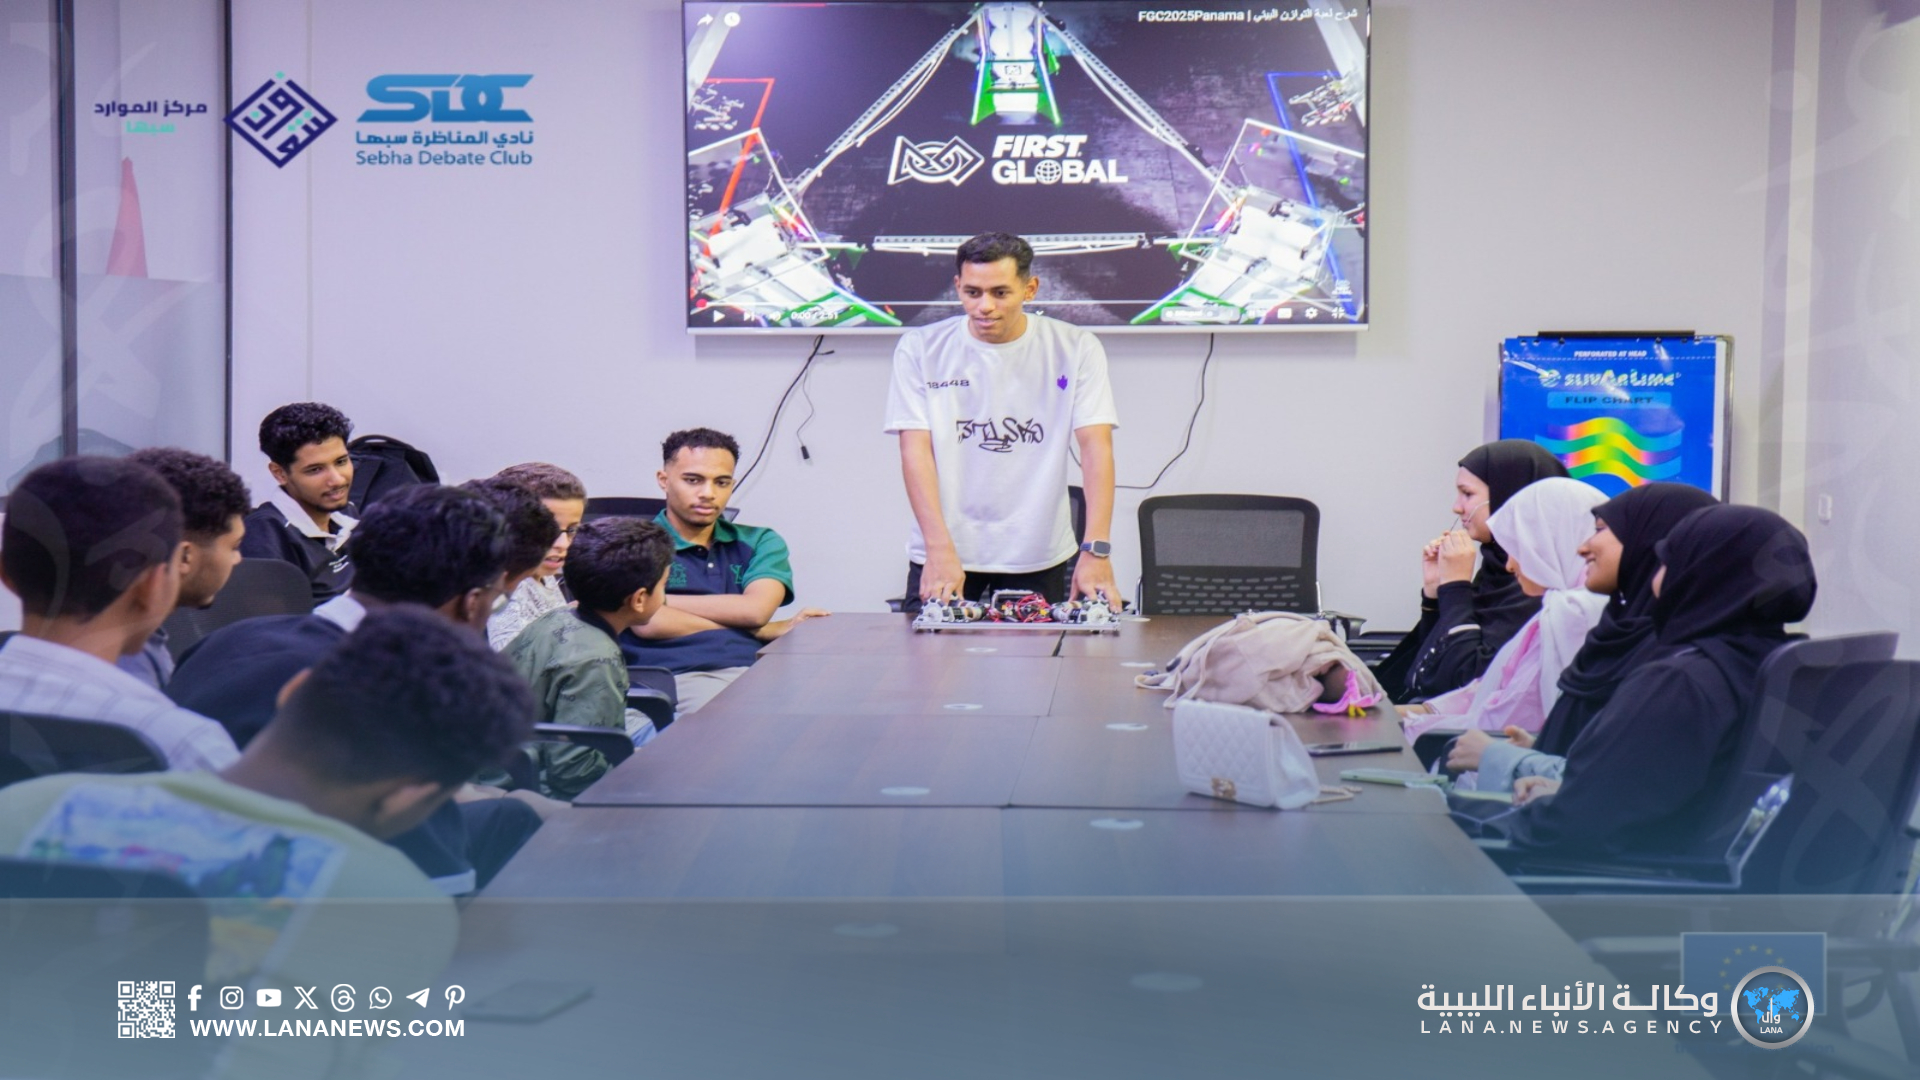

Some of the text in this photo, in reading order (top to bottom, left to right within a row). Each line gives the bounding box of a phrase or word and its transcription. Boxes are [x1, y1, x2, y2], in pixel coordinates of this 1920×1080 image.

[1138, 10, 1244, 22] FGC2025Panama
[1334, 8, 1358, 20] شرح
[992, 134, 1087, 158] FIRST
[992, 159, 1129, 185] GLOBAL
[1565, 396, 1597, 404] FLIP
